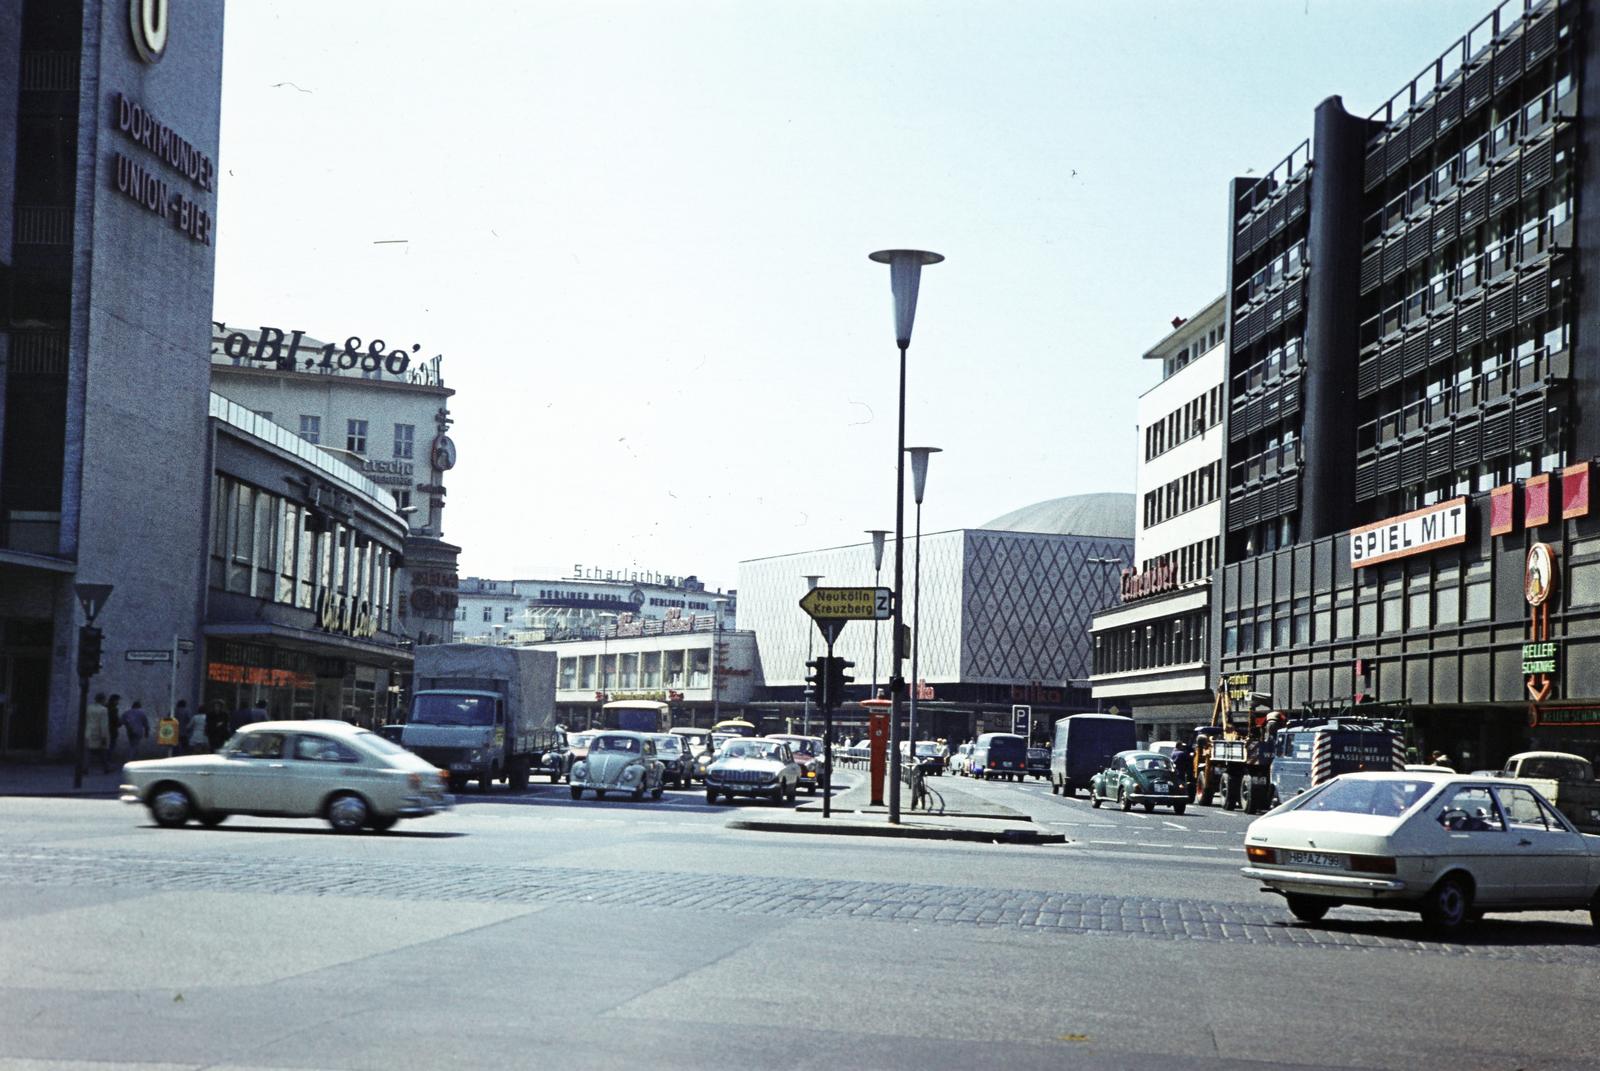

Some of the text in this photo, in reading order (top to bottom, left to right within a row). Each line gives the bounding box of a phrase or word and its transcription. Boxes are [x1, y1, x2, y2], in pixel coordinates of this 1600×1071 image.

[116, 92, 213, 193] DORTMUNDER
[116, 152, 211, 246] UNION-BIER
[1353, 507, 1461, 559] SPIEL MIT
[540, 590, 622, 602] BERLINER KINDL
[816, 590, 870, 601] Neukölln
[650, 597, 709, 611] BERLINER KINDL
[814, 603, 873, 615] Kreuzberg
[877, 596, 887, 611] Z
[1522, 643, 1556, 659] KELLER-
[1016, 709, 1026, 723] P
[1344, 745, 1378, 753] BERLNER
